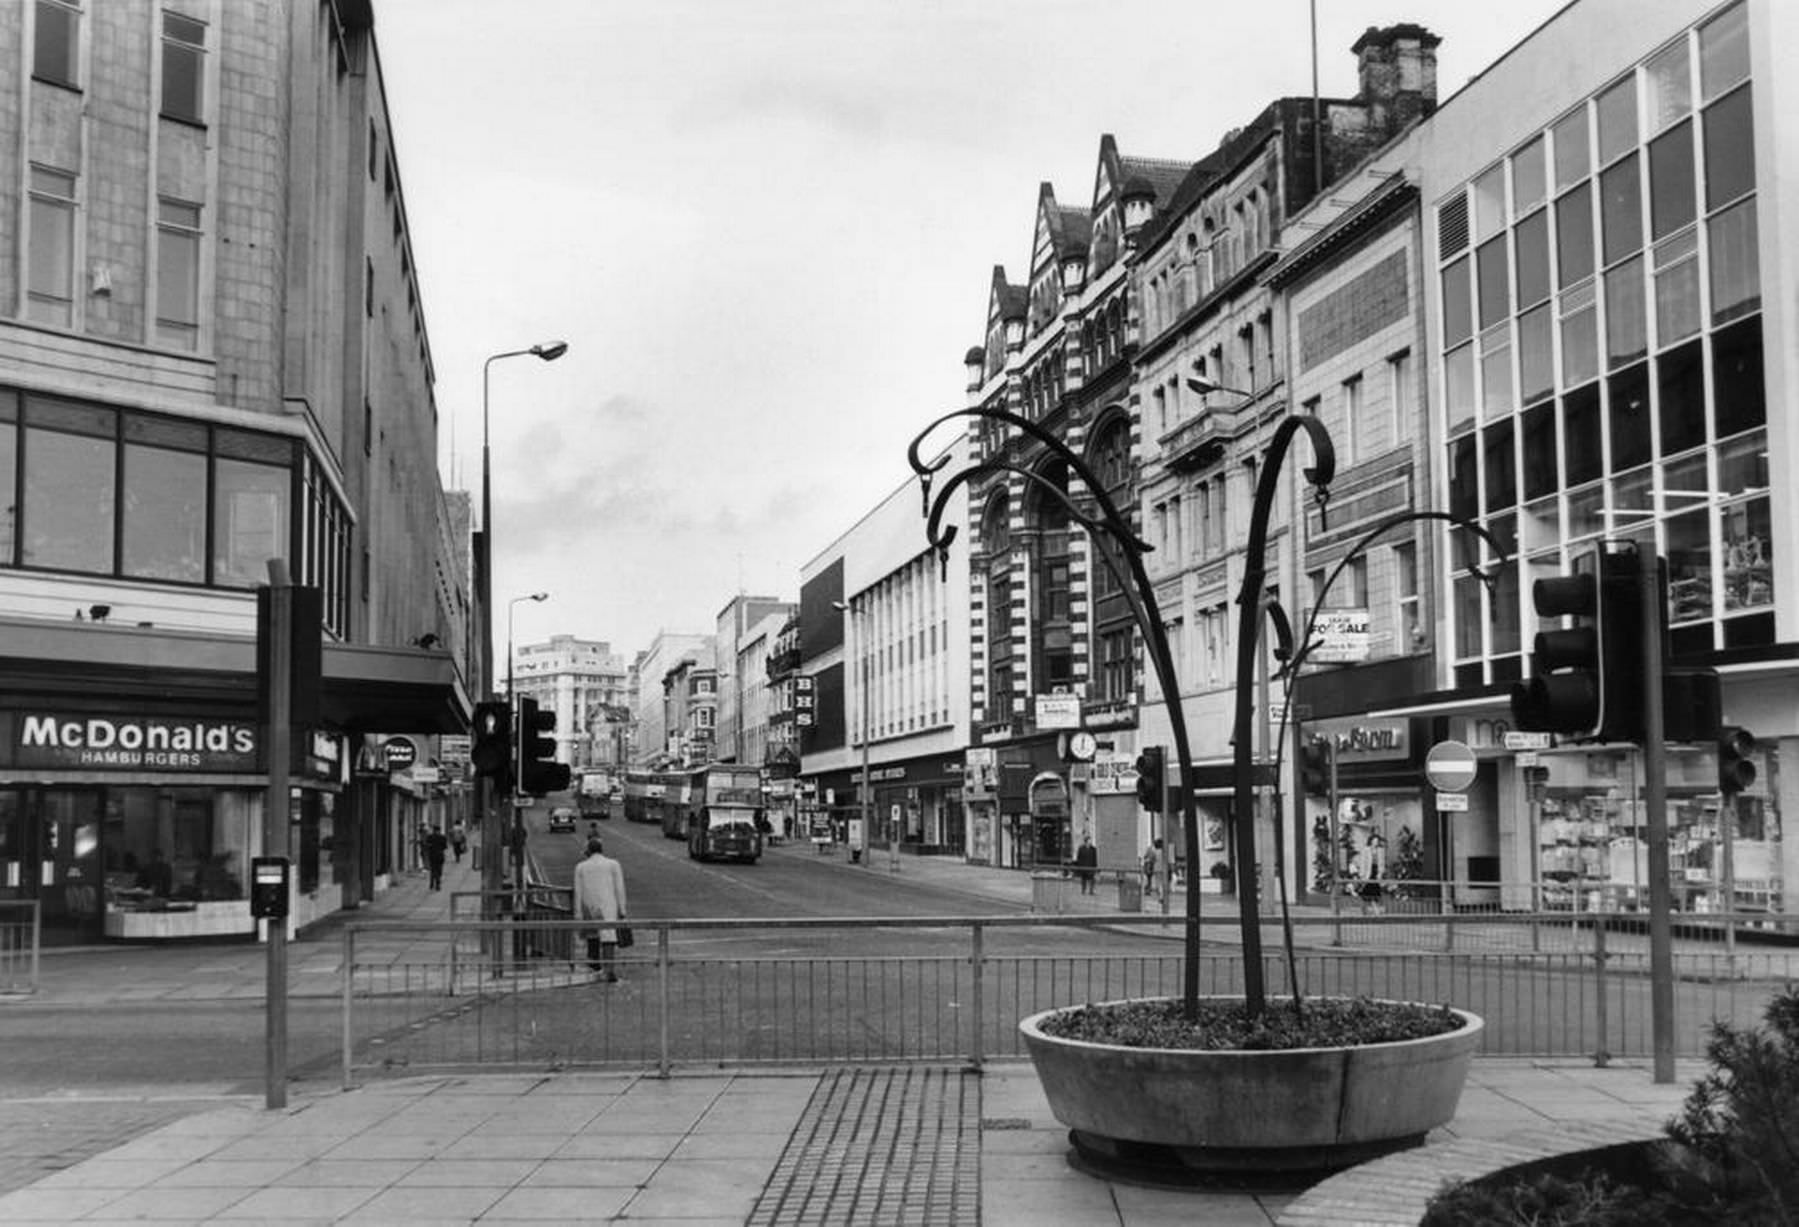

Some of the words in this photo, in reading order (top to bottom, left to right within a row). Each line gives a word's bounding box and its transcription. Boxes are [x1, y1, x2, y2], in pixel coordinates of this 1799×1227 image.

[796, 678, 812, 726] BHS
[22, 715, 254, 753] McDonald's
[81, 751, 201, 766] HAMBURGERS
